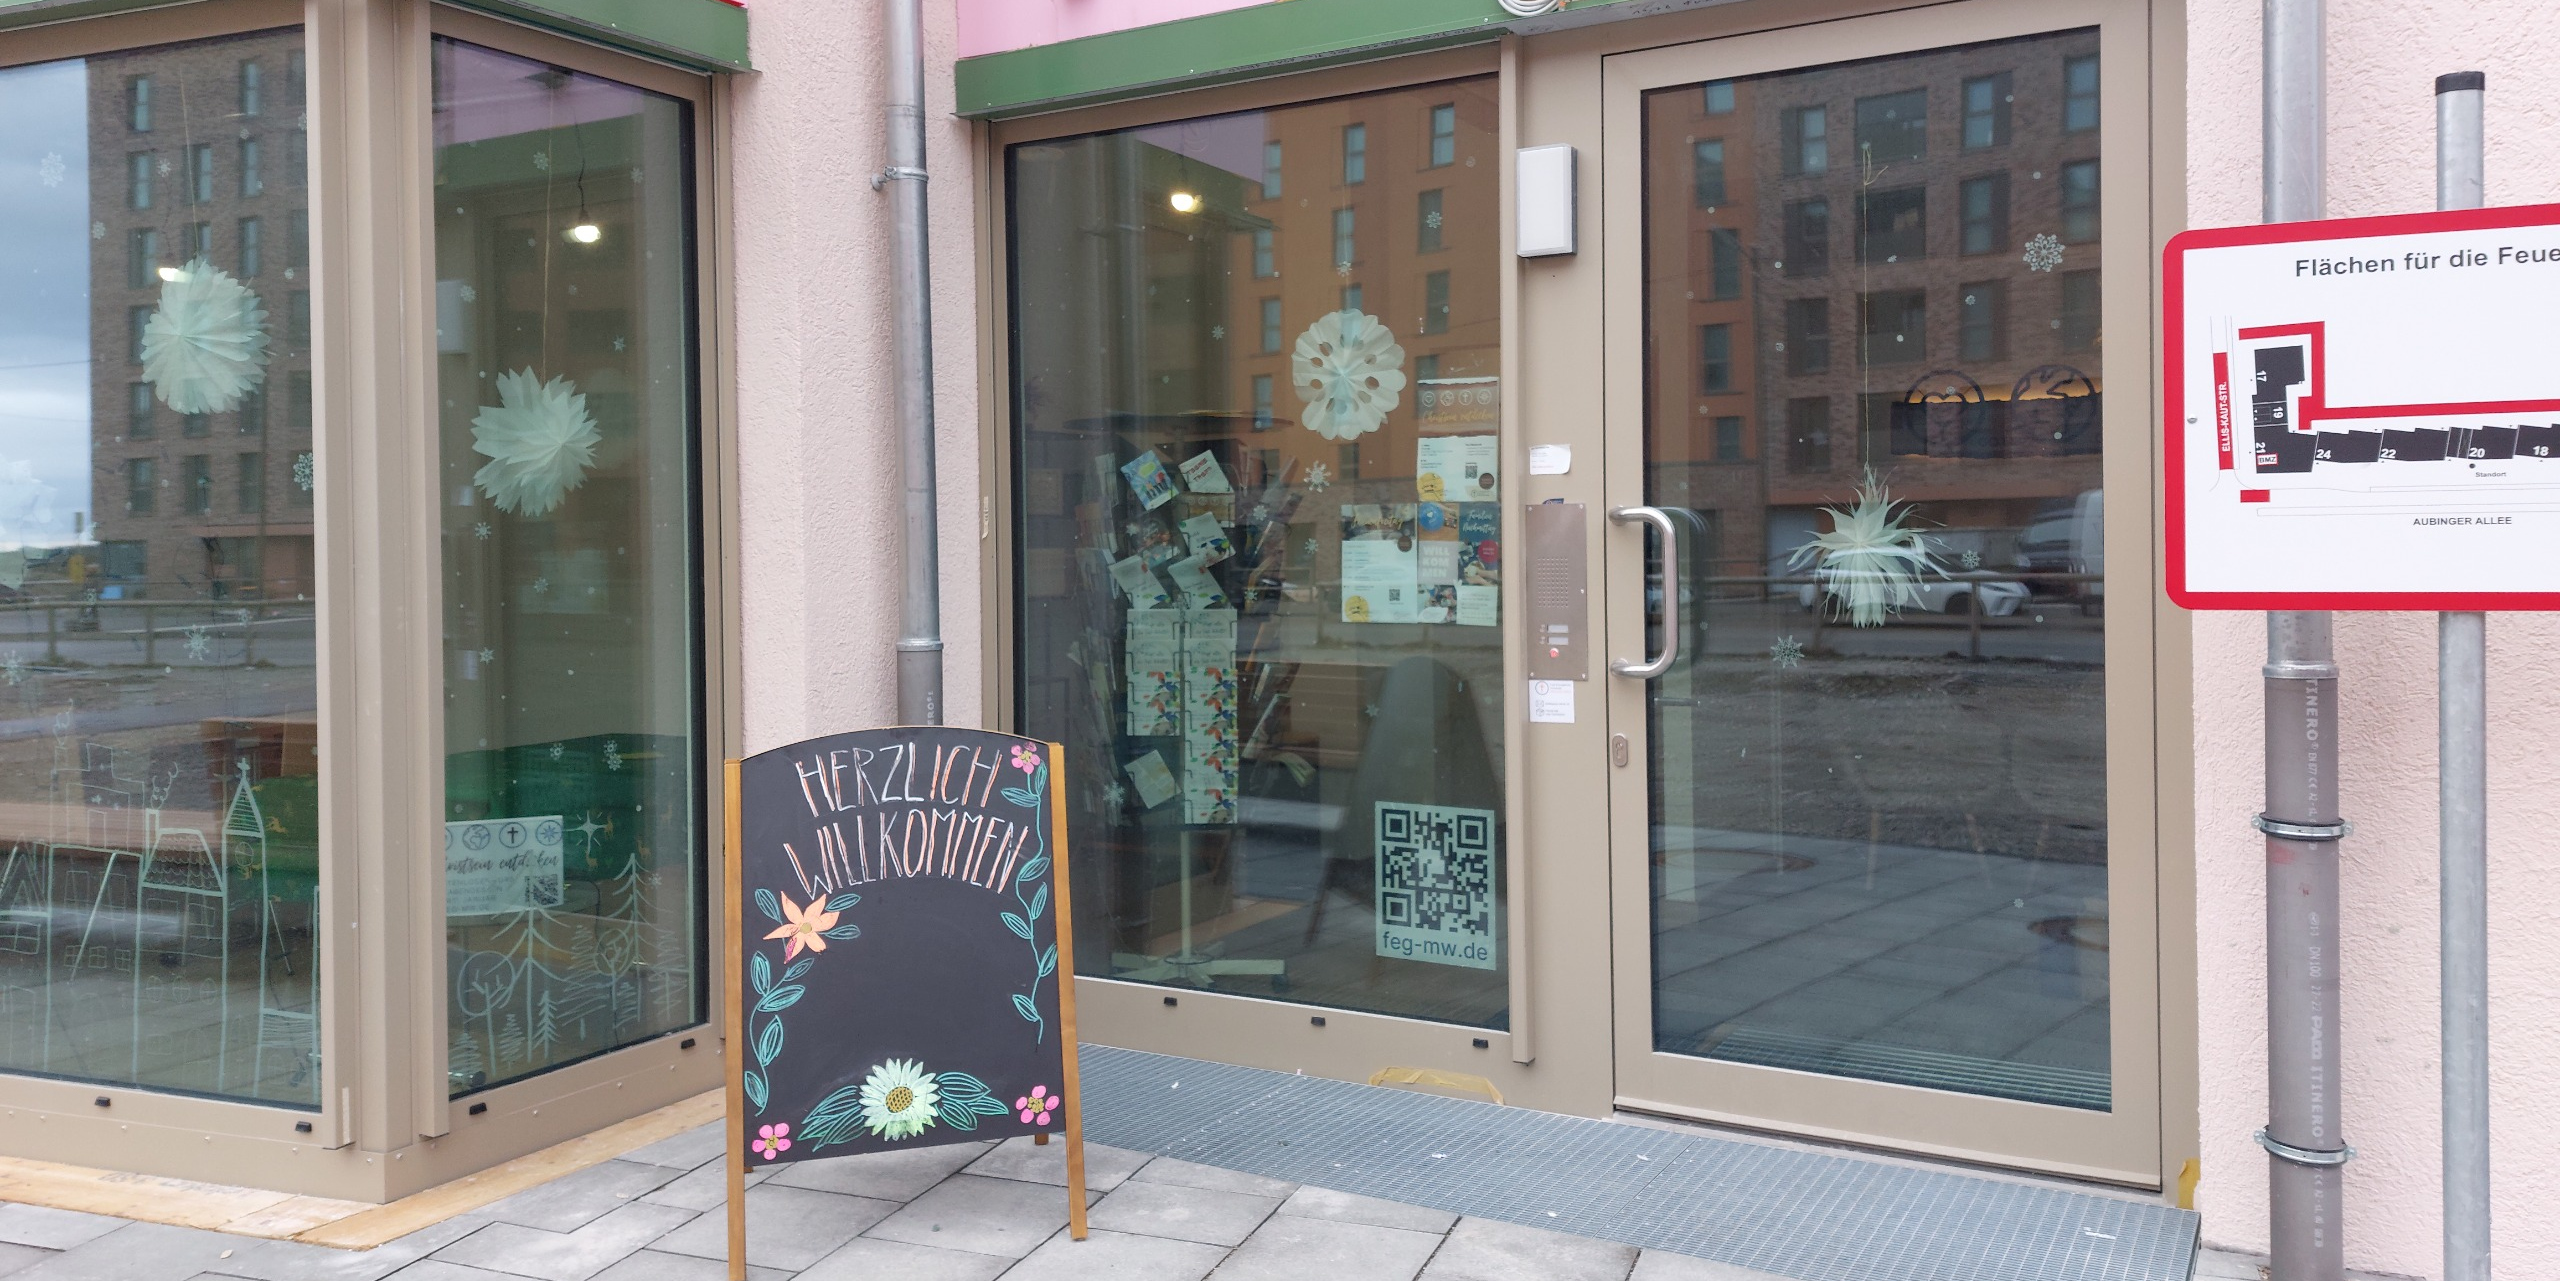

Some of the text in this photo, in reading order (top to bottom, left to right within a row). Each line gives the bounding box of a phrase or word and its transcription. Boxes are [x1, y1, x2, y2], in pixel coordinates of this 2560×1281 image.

[2295, 257, 2395, 277] Flächen
[2404, 252, 2441, 271] für
[2450, 249, 2488, 267] die
[2256, 370, 2267, 382] 17
[2218, 381, 2231, 452] ELLIS-KAUT-STR.
[2273, 406, 2284, 419] 19
[2256, 442, 2266, 454] 21
[2316, 449, 2331, 459] 24
[2381, 449, 2397, 459] 22
[2469, 448, 2485, 458] 20
[2533, 446, 2549, 457] 18
[2413, 516, 2512, 526] AUBINGER ALLEE
[795, 741, 1003, 818] HERZLICH
[783, 808, 1029, 900] WILLKOMMEN
[1382, 931, 1488, 960] feg-mw.de
